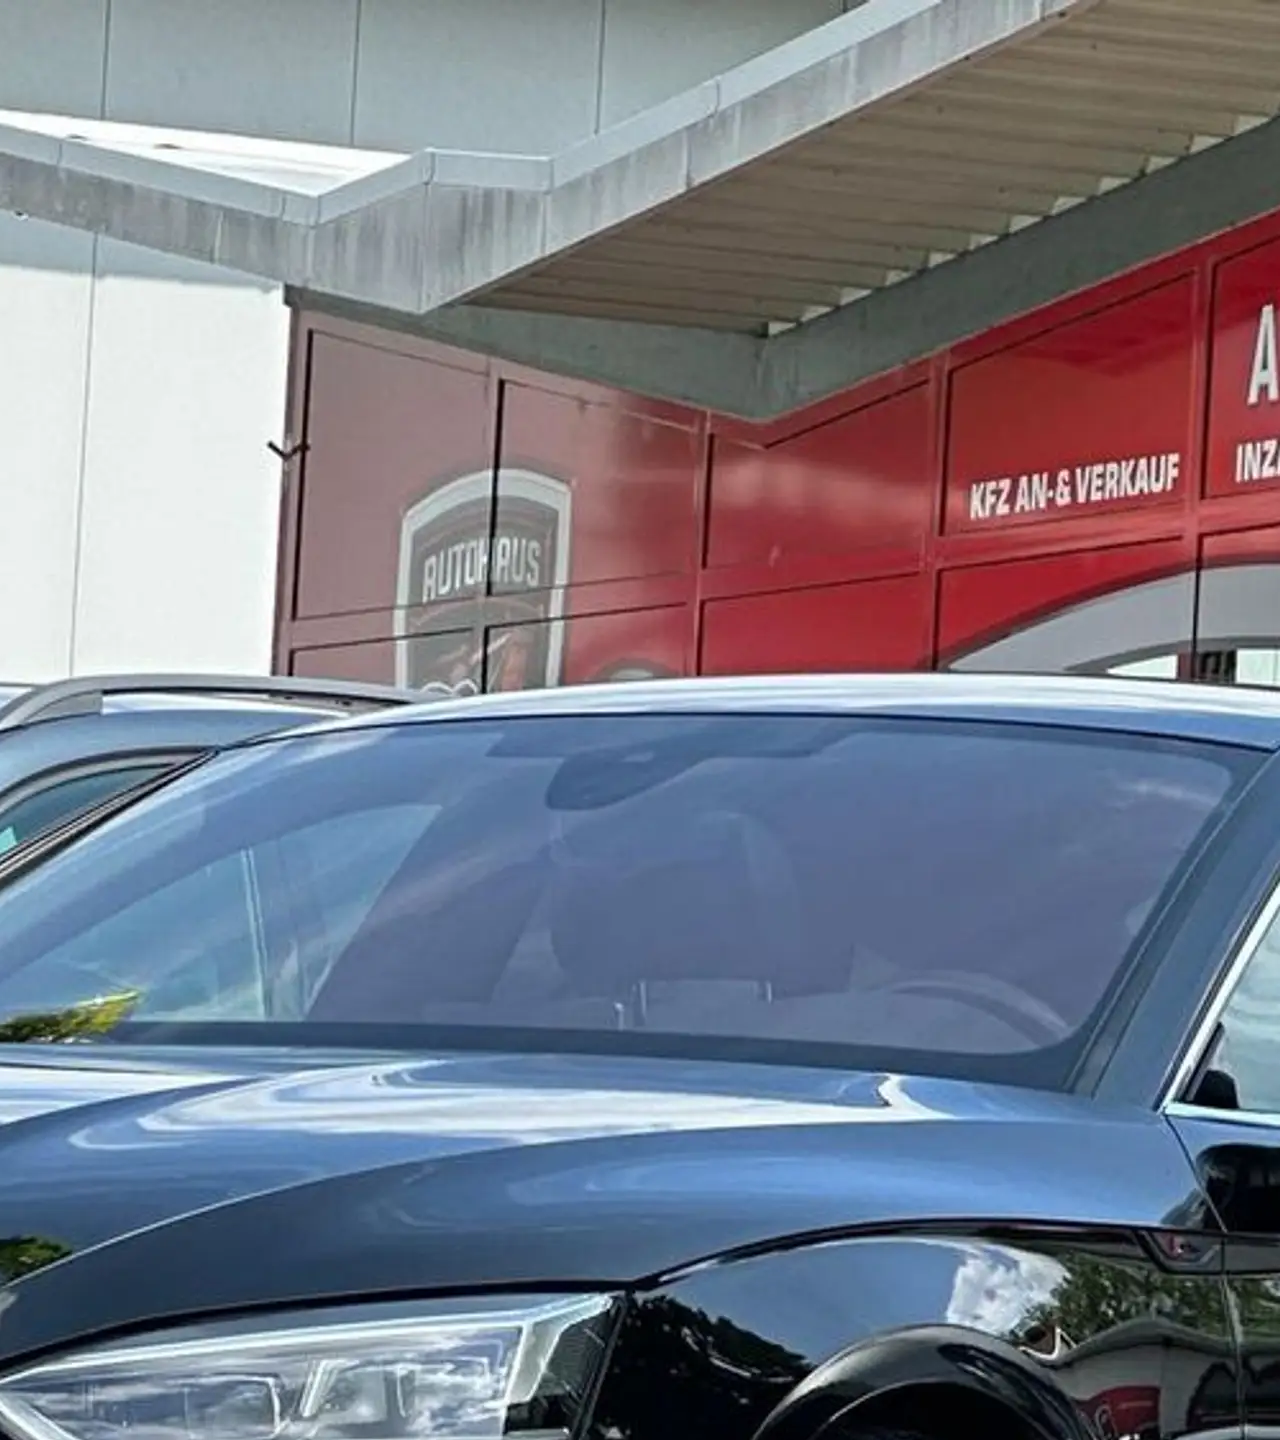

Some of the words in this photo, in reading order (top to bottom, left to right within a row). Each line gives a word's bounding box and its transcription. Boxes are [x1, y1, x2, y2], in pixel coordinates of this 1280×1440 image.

[970, 478, 1012, 520] KFZ
[1075, 452, 1180, 504] VERKAUF
[422, 536, 542, 604] AUTOHAUS
